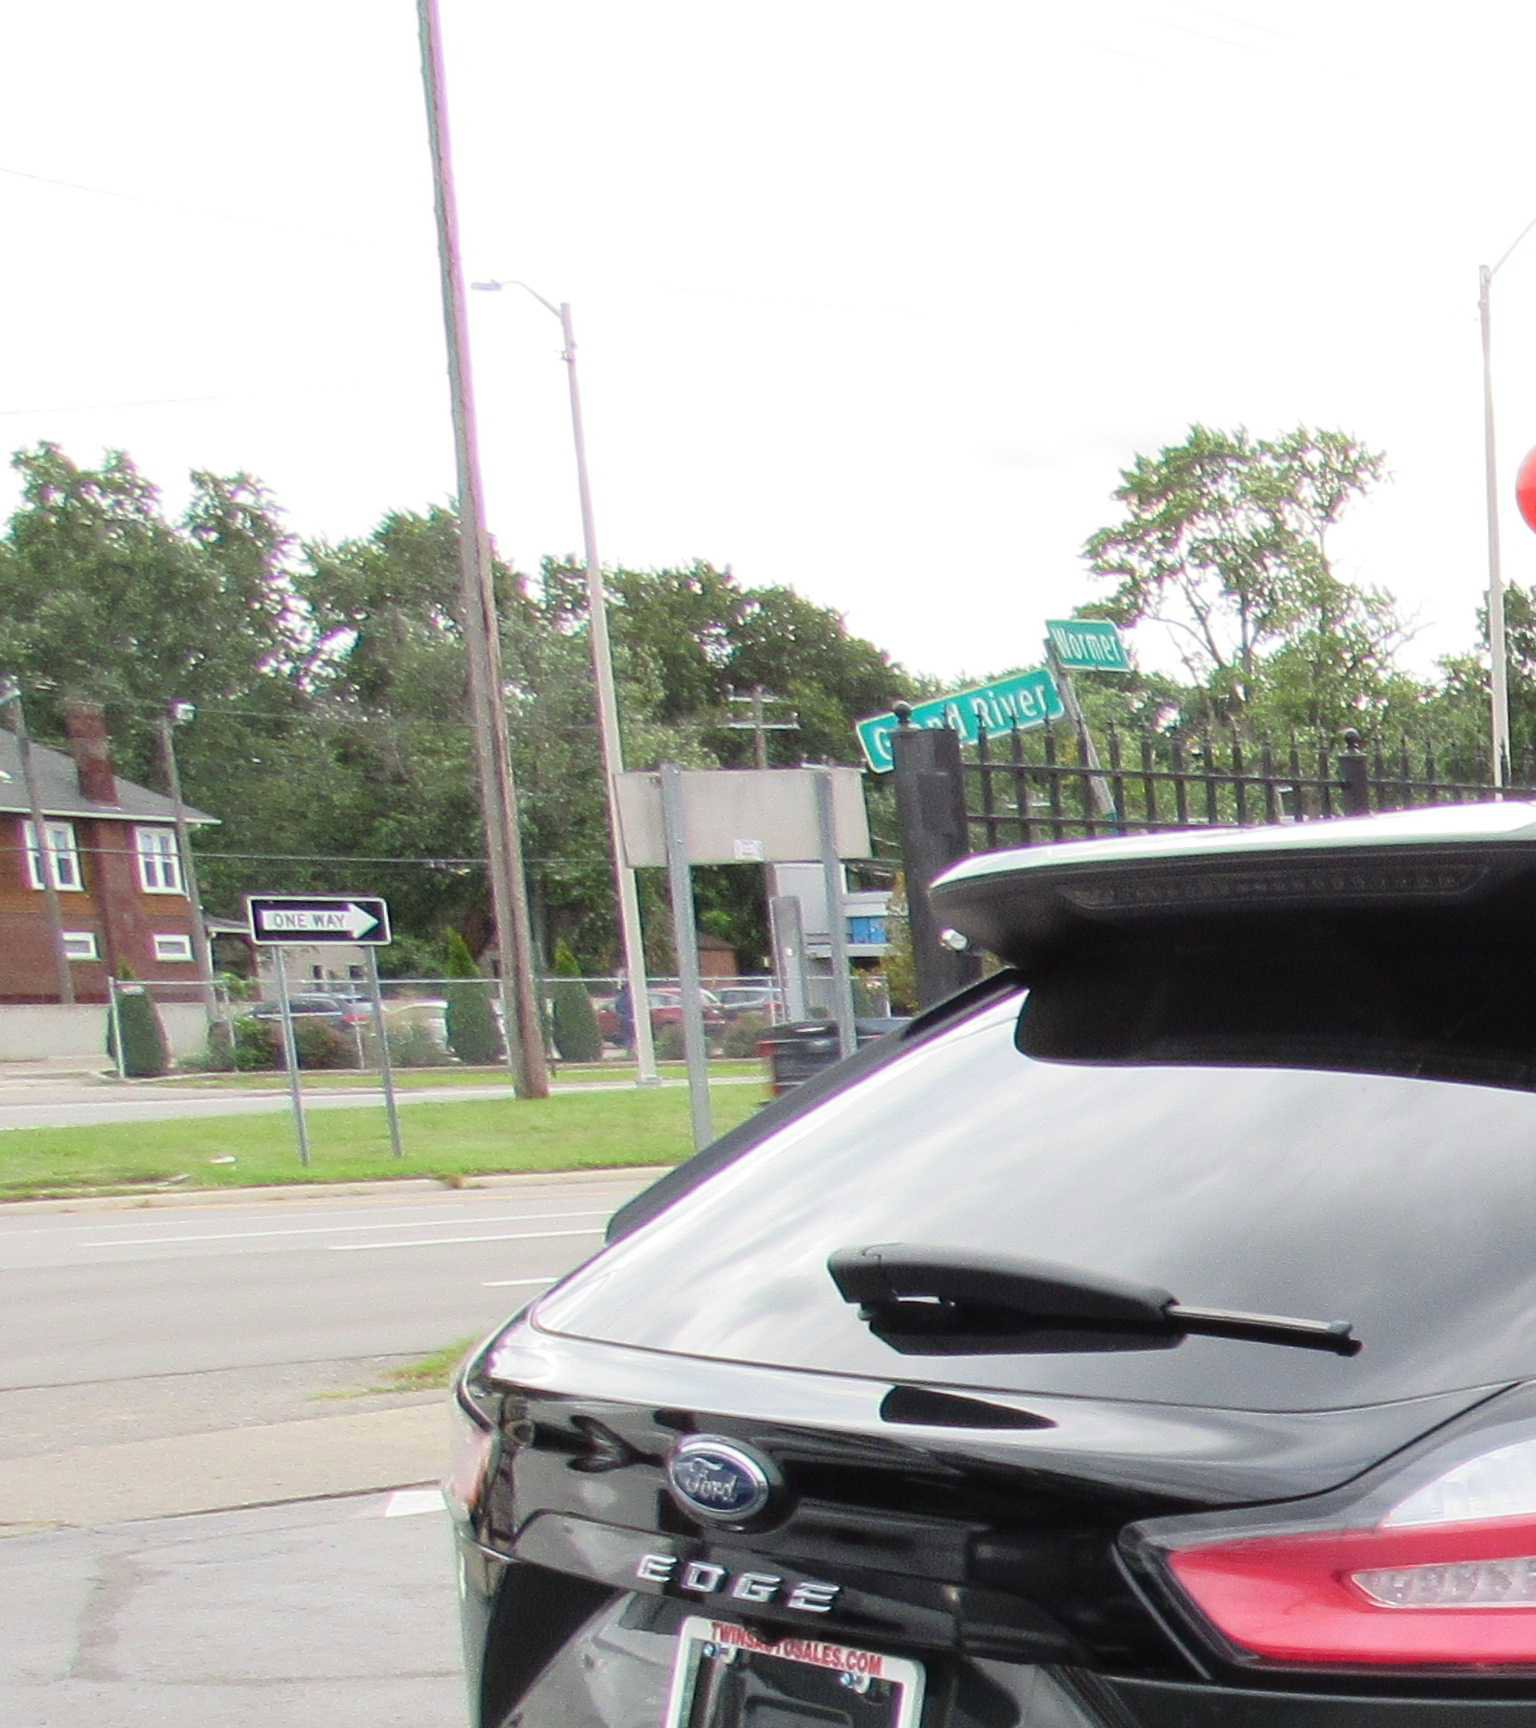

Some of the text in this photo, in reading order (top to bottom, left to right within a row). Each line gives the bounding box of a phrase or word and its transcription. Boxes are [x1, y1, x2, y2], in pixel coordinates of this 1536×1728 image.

[1050, 627, 1122, 662] Wormer
[971, 684, 1047, 729] River
[273, 913, 345, 928] ONE WAY
[675, 1457, 738, 1503] Ford
[637, 1554, 841, 1613] EDGE
